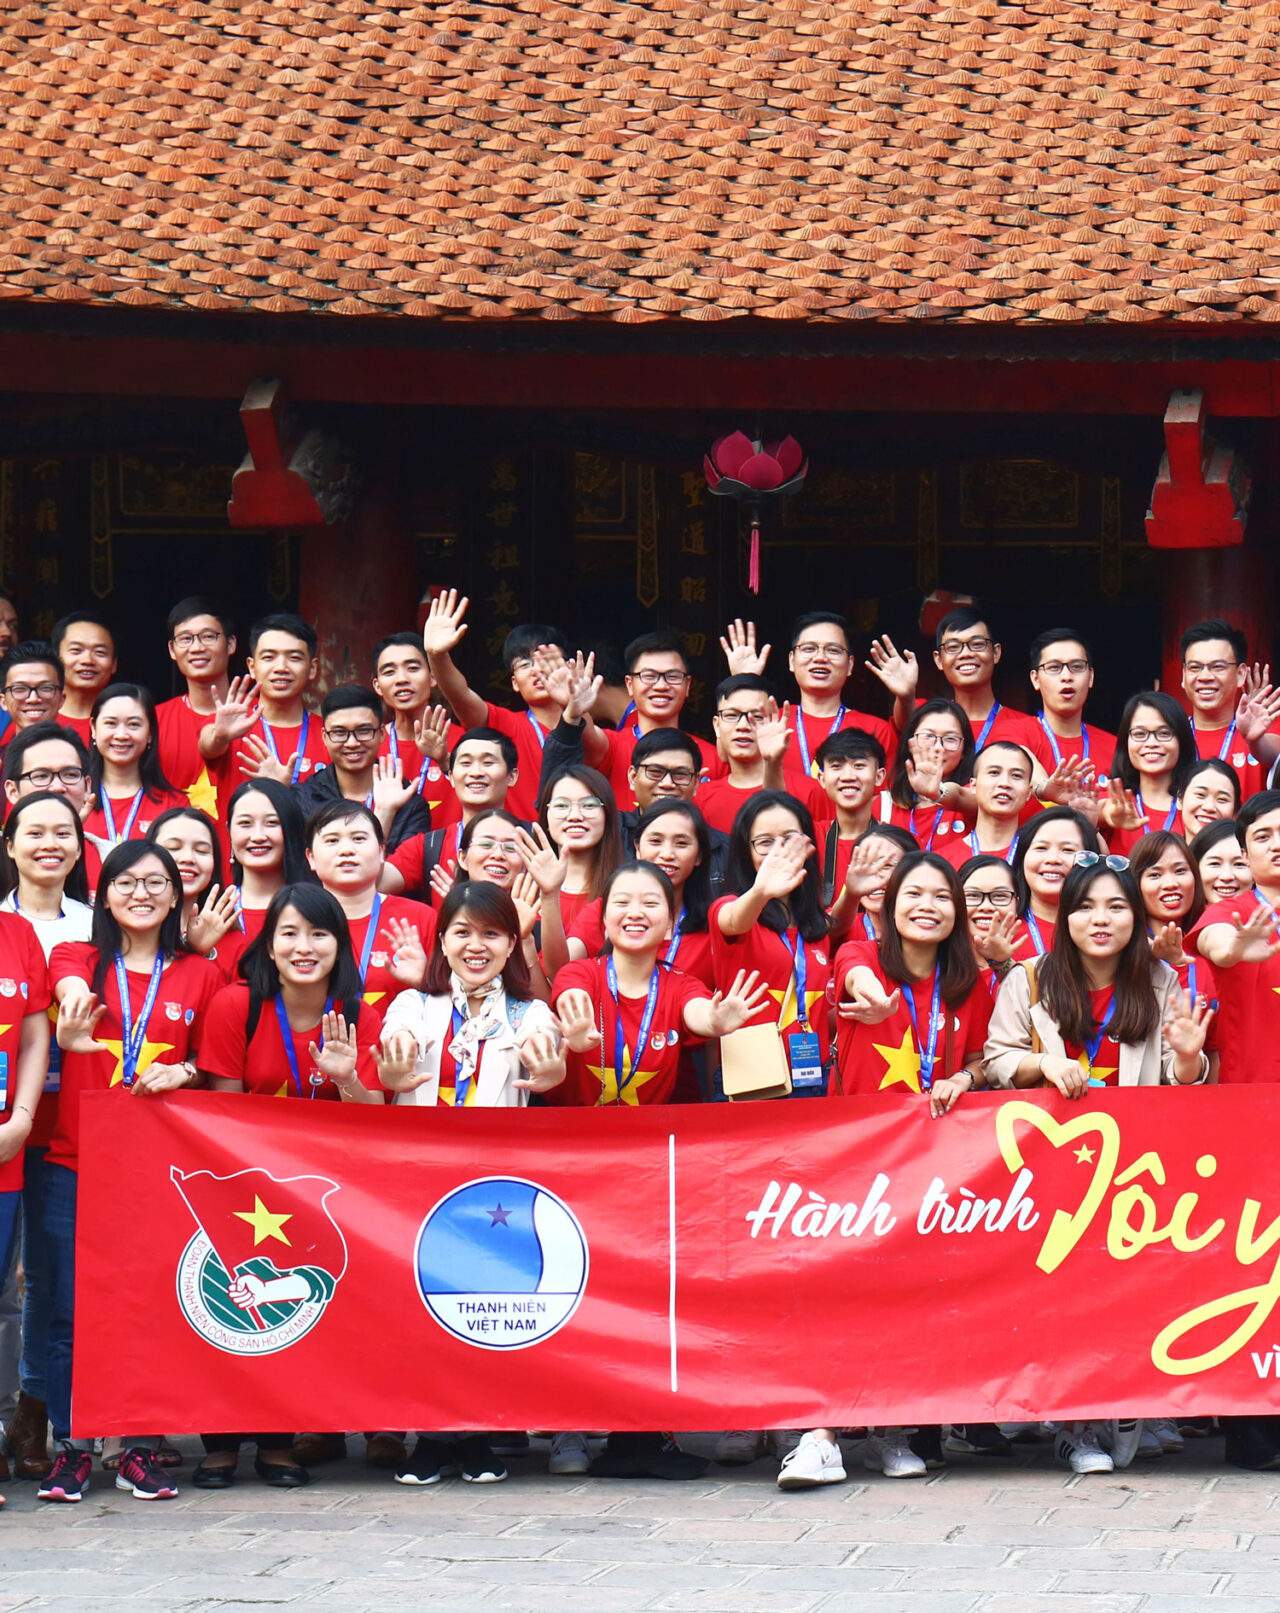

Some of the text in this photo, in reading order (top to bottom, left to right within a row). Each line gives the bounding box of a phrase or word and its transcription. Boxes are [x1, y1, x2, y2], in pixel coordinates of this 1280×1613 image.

[745, 1172, 897, 1239] Hành
[917, 1167, 1041, 1234] trình
[457, 1299, 546, 1314] THANH NIÊN
[466, 1316, 537, 1334] VIỆT NAM
